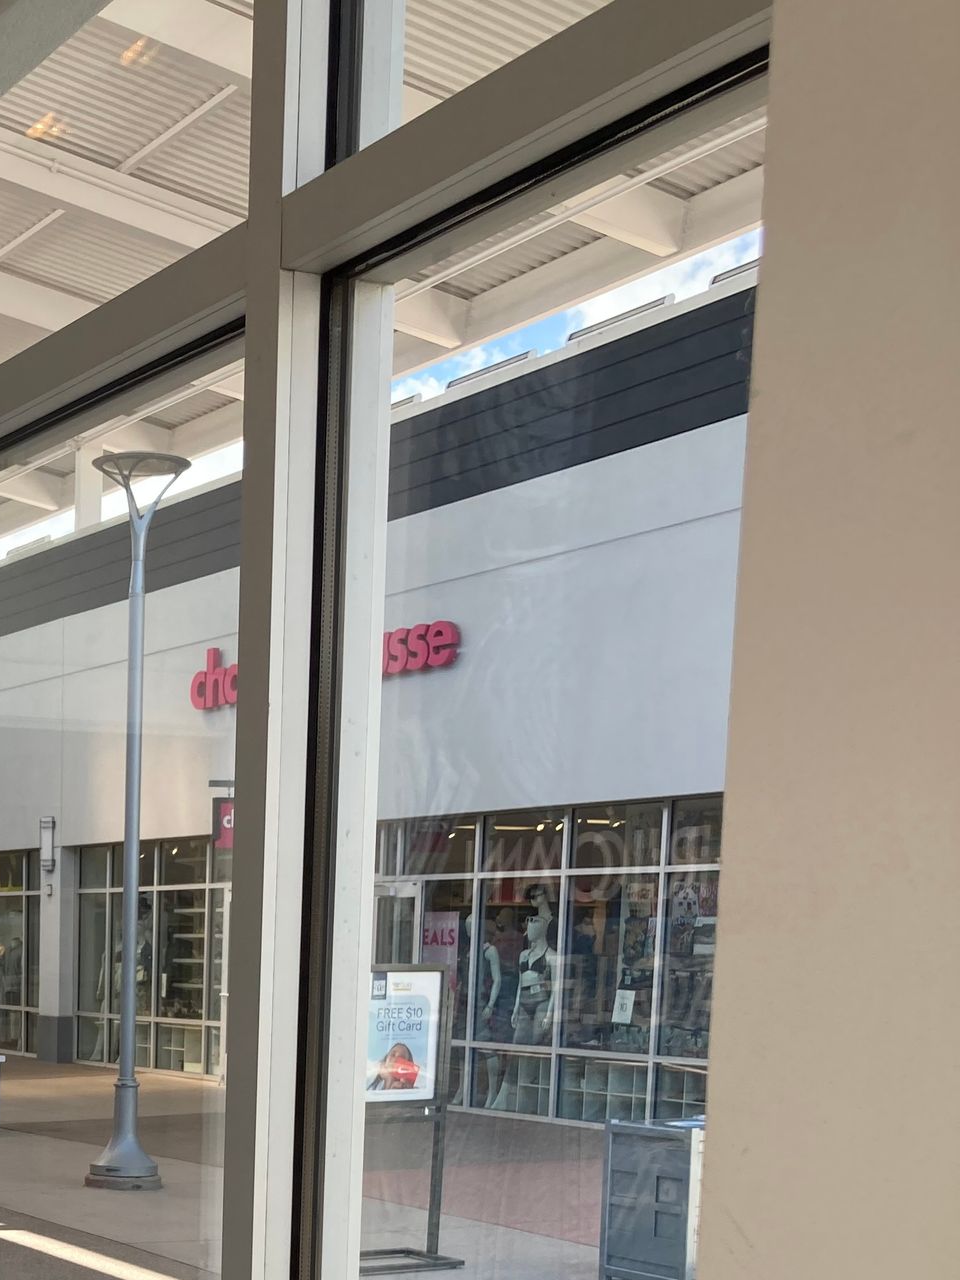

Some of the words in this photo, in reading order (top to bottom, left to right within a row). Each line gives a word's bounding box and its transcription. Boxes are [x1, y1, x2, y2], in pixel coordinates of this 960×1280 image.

[383, 620, 460, 676] sse
[377, 1007, 404, 1019] FREE
[405, 1006, 423, 1020] $10
[376, 1020, 396, 1032] Gift
[397, 1020, 423, 1032] Card
